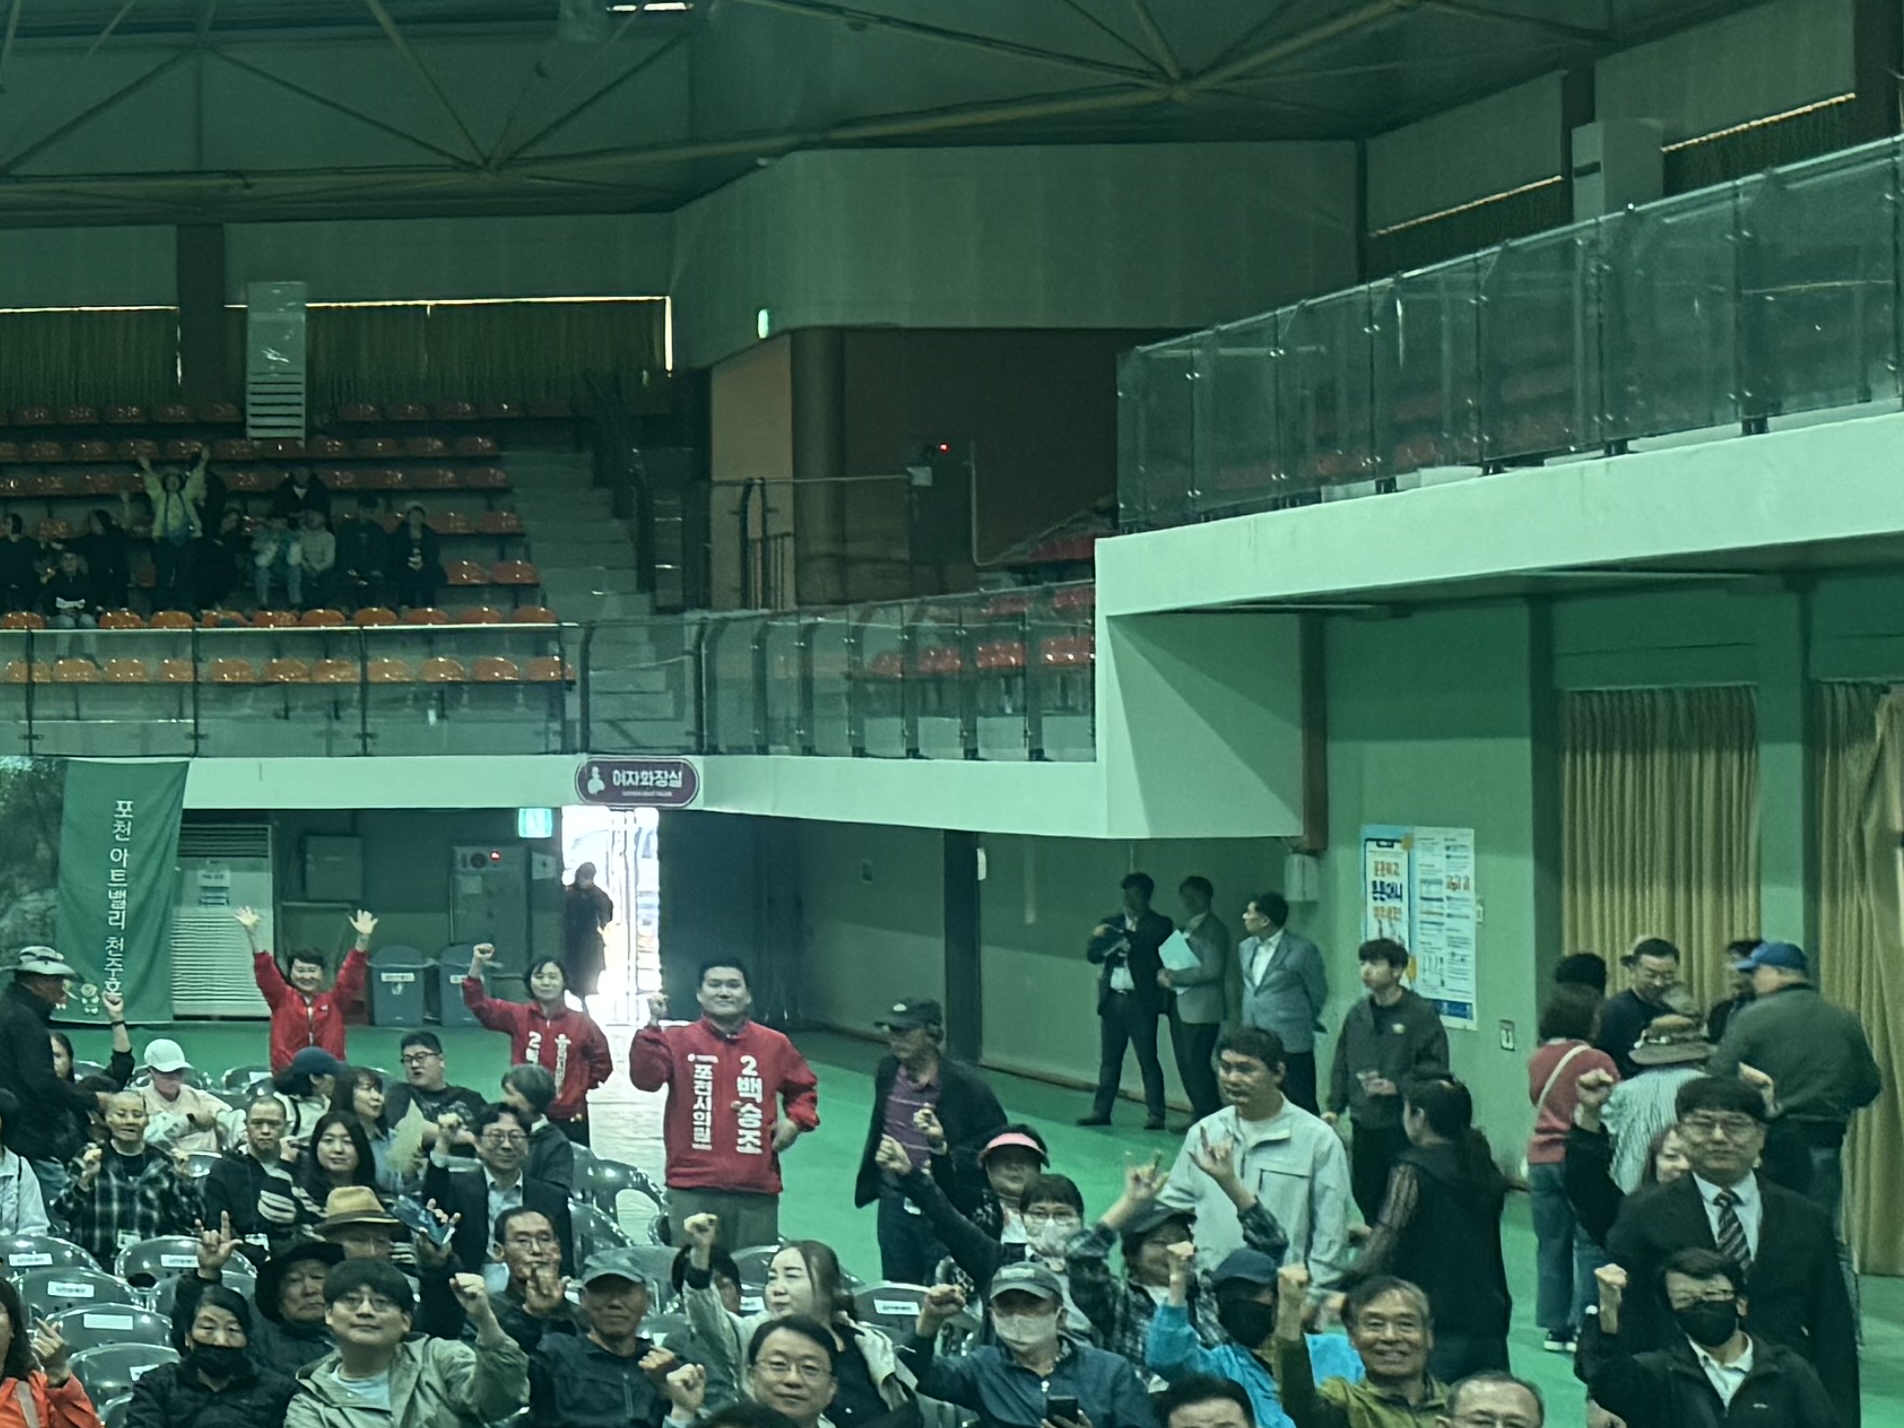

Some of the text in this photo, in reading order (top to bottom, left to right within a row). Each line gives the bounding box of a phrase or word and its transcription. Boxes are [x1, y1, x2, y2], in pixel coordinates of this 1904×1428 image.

[612, 768, 683, 788] 여자화장실
[113, 800, 134, 842] 포천
[106, 847, 129, 930] 아트밸리
[739, 1055, 759, 1076] 2
[692, 1063, 714, 1144] 포천시의원
